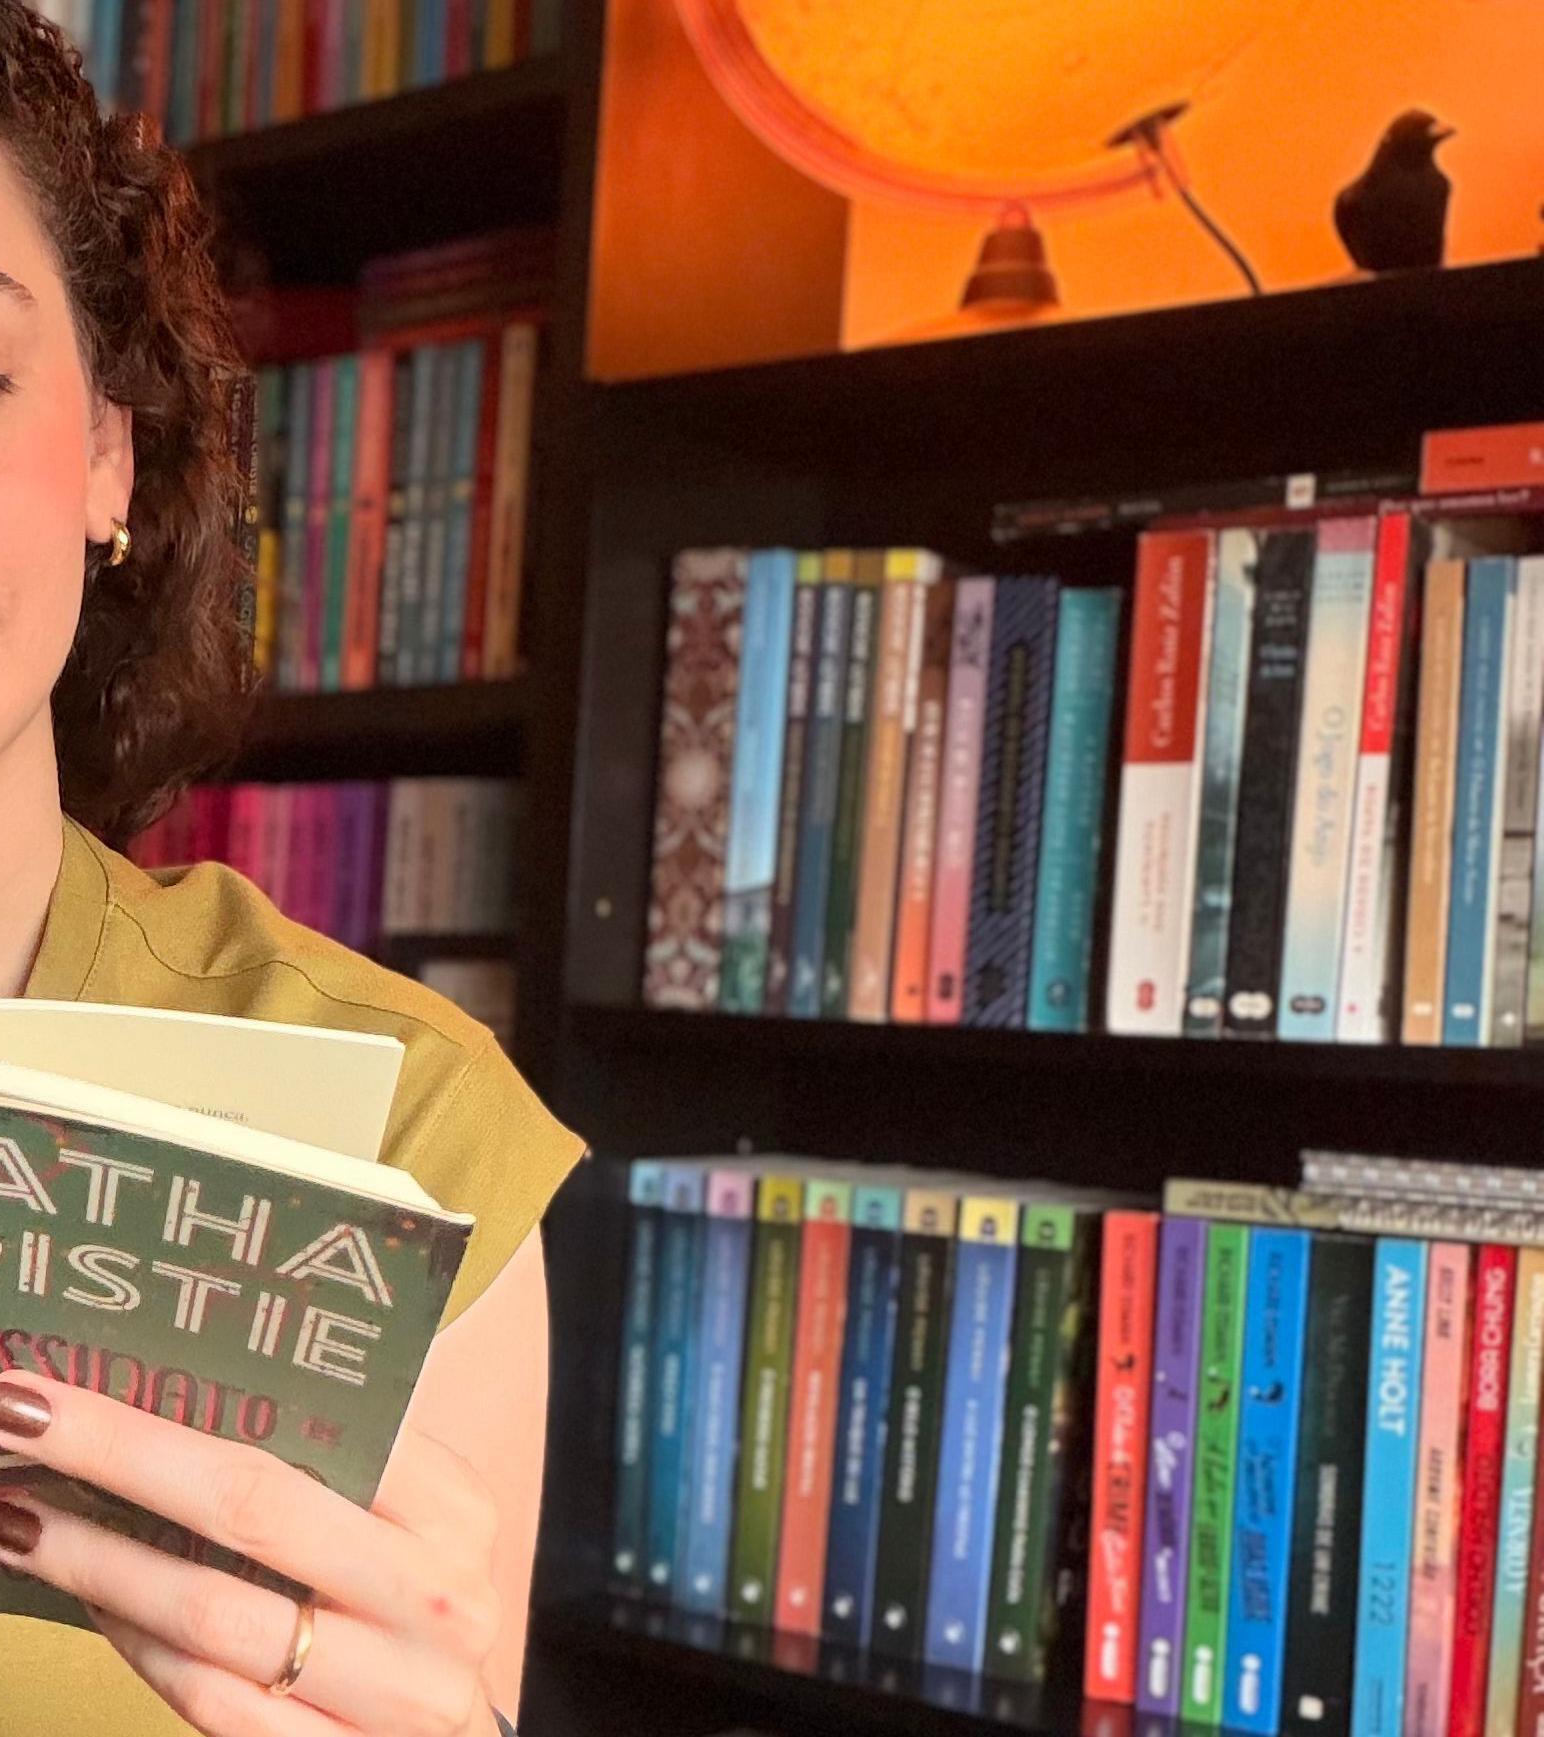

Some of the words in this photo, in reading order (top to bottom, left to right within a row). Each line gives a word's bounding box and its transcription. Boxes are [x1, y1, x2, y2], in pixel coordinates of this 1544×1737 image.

[1380, 1264, 1414, 1349] ANNE
[1479, 1266, 1508, 1347] CHUNG
[1376, 1355, 1409, 1435] HOLT
[1475, 1350, 1503, 1411] BORA
[1366, 1560, 1398, 1627] 1222
